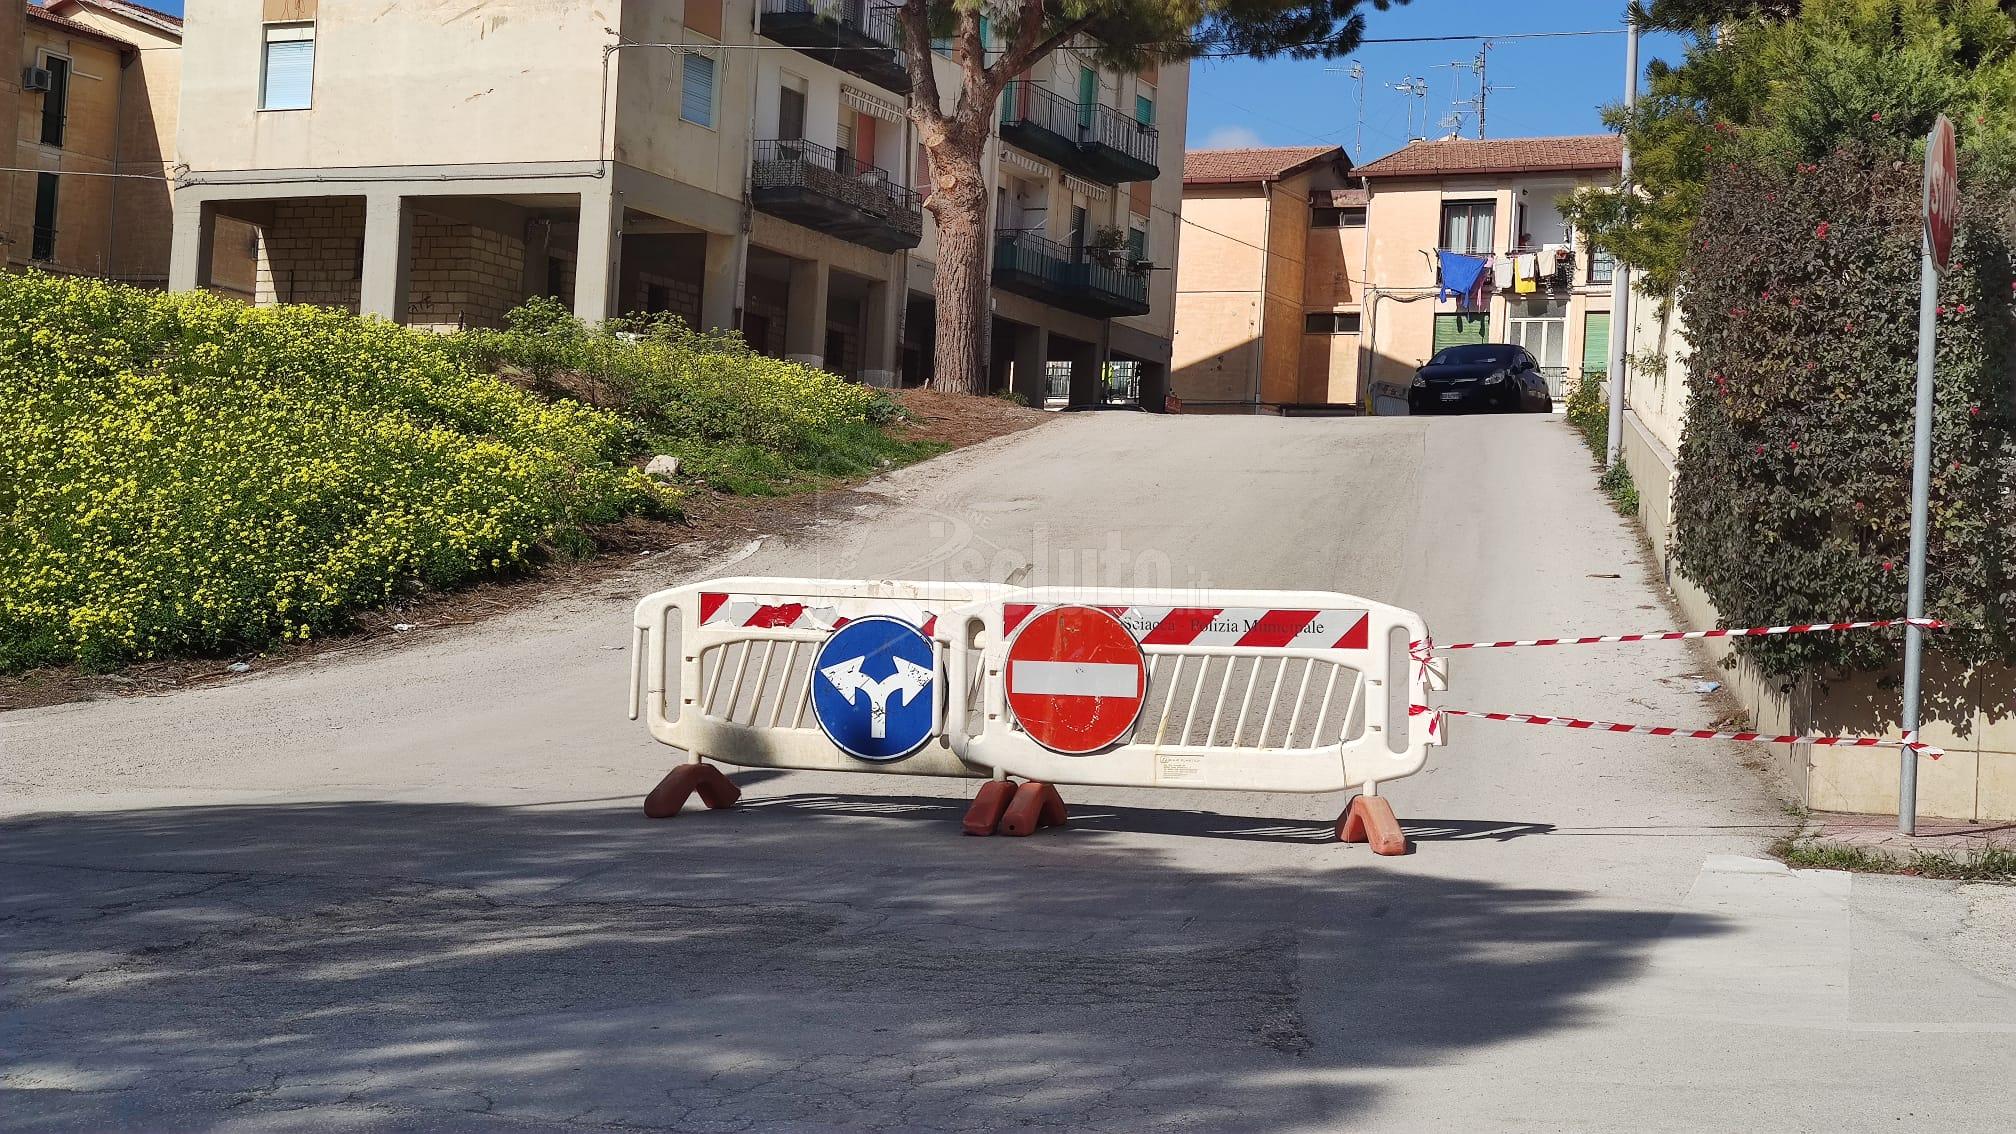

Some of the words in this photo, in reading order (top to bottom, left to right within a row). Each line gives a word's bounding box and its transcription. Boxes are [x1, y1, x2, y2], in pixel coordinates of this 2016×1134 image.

[1930, 160, 1956, 232] STOP
[1123, 615, 1175, 631] Sciacca
[1191, 617, 1239, 633] Polizia
[1243, 618, 1325, 637] Municipale
